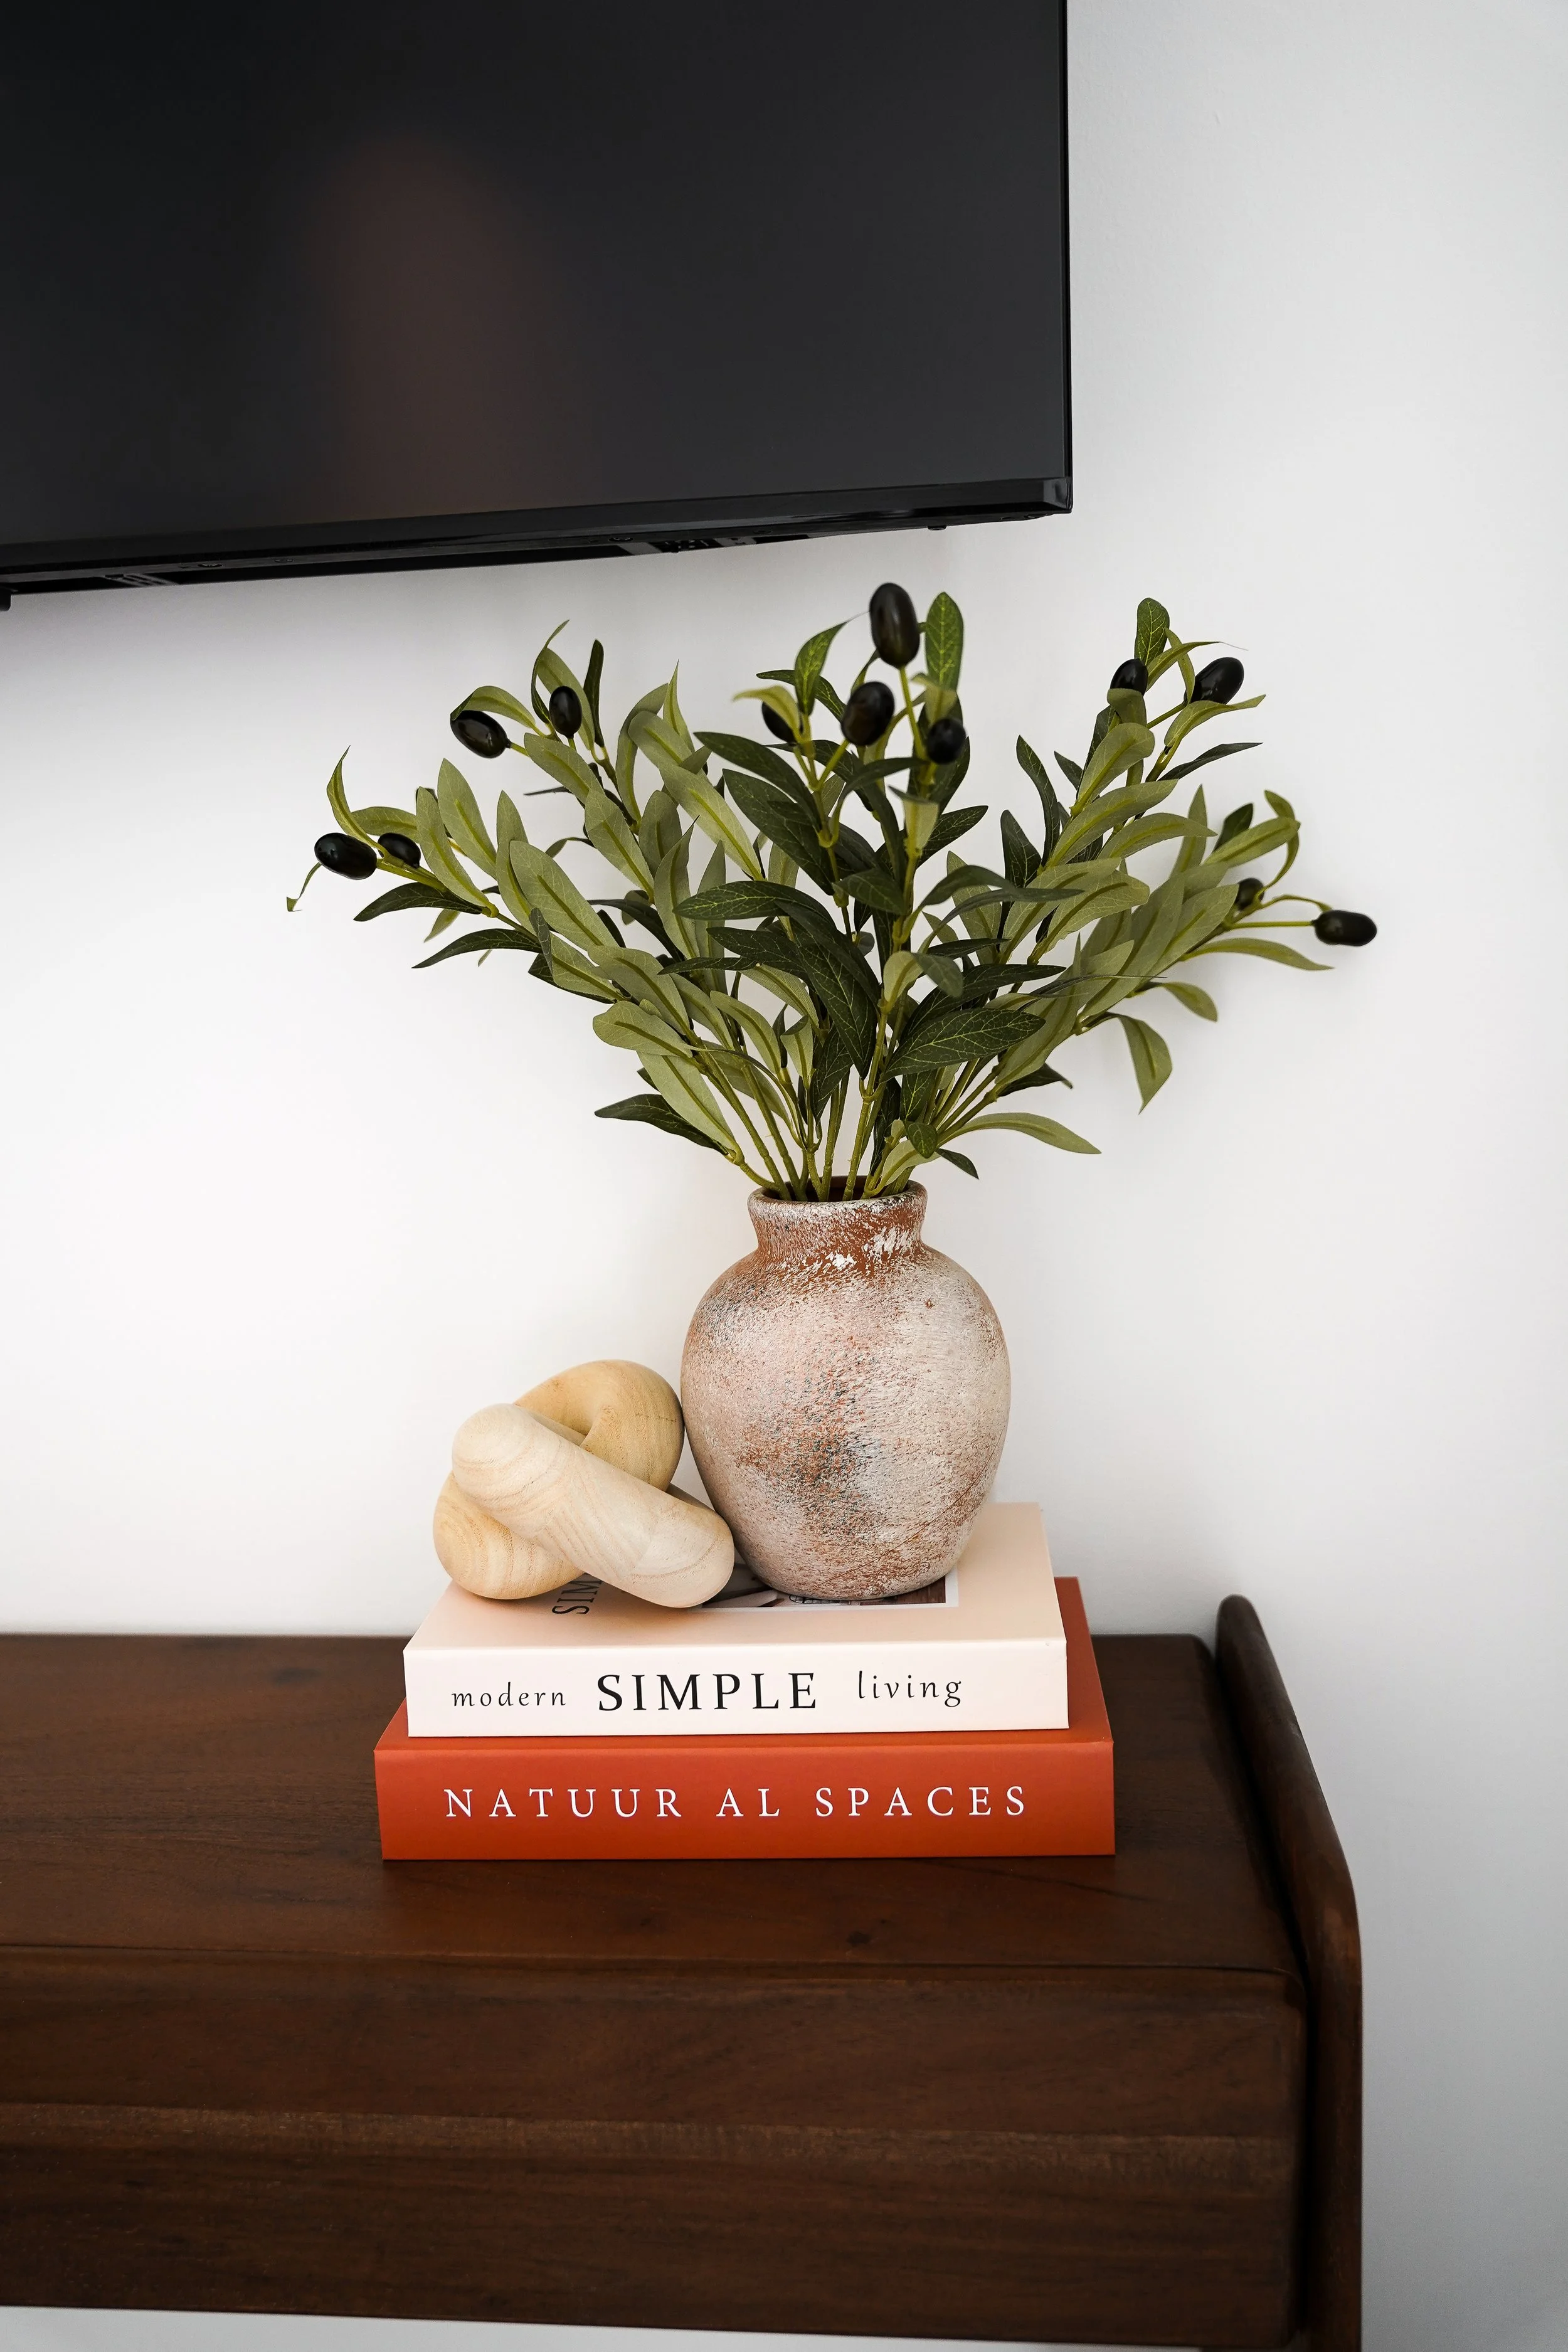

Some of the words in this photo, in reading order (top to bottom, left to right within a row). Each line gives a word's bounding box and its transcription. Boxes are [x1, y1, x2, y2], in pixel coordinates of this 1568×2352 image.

[450, 1681, 567, 1707] modern
[597, 1672, 817, 1712] SIMPLE
[858, 1670, 962, 1708] living
[815, 1786, 1025, 1817] SPACES
